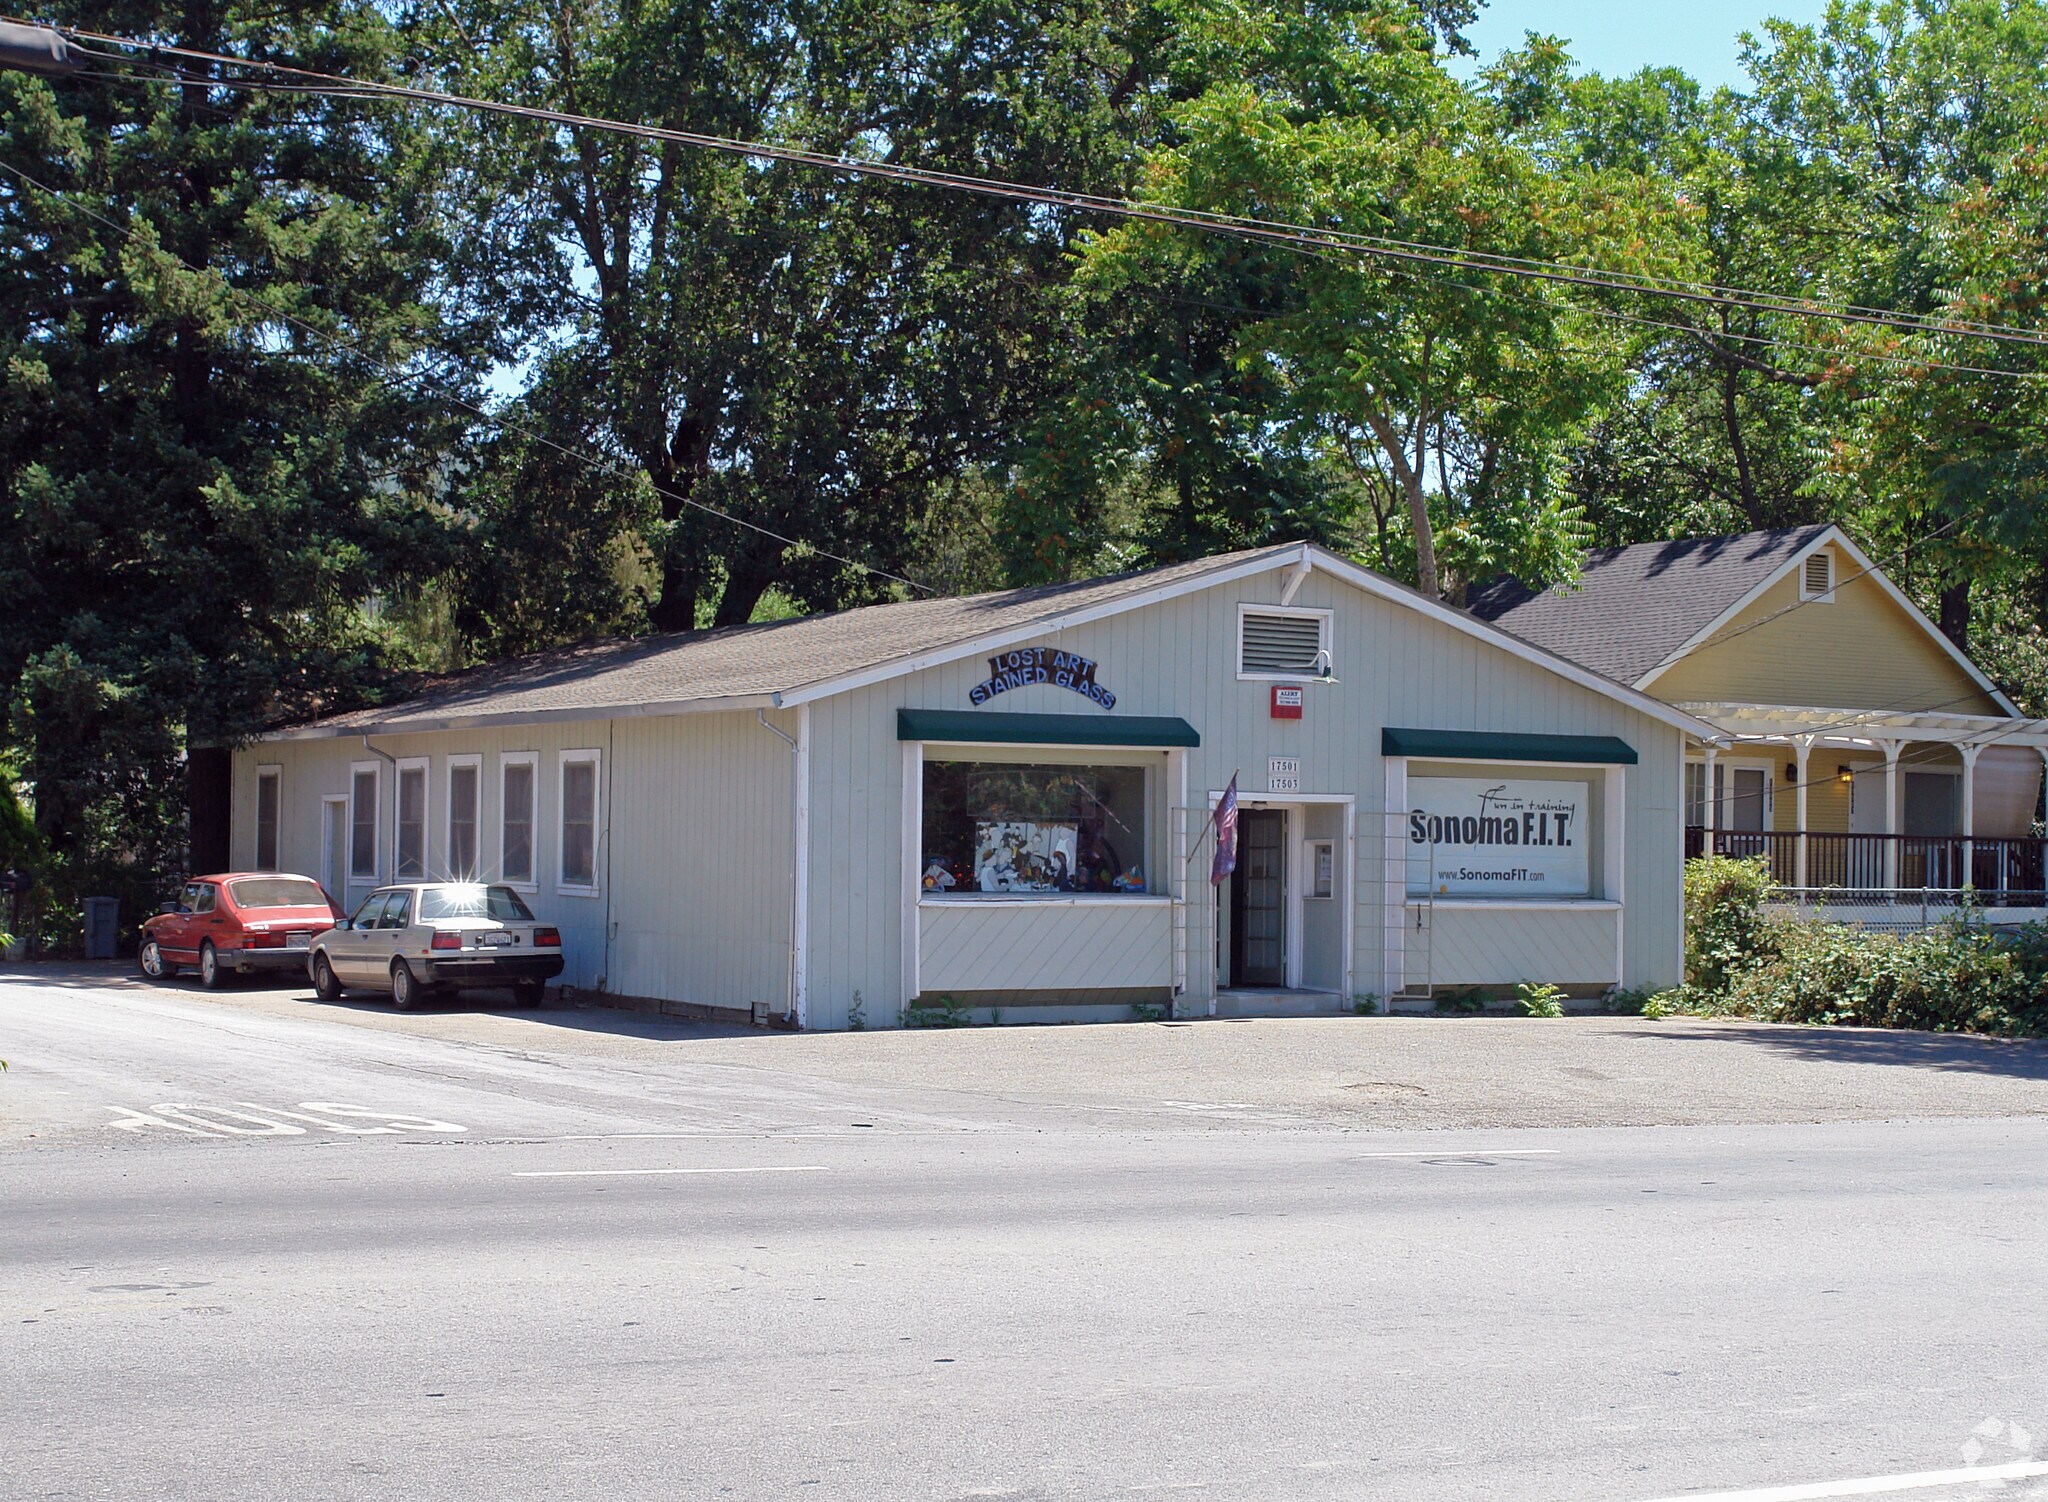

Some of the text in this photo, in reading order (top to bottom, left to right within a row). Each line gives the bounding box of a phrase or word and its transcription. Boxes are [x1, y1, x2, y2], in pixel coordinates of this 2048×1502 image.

[996, 648, 1094, 675] LOST ART
[971, 667, 1115, 709] STAINED GLASS
[1271, 761, 1297, 772] 17501
[1271, 779, 1298, 789] 17503
[1510, 801, 1524, 810] in
[1529, 799, 1575, 828] training
[1438, 867, 1545, 882] www.SonomaFIT.com
